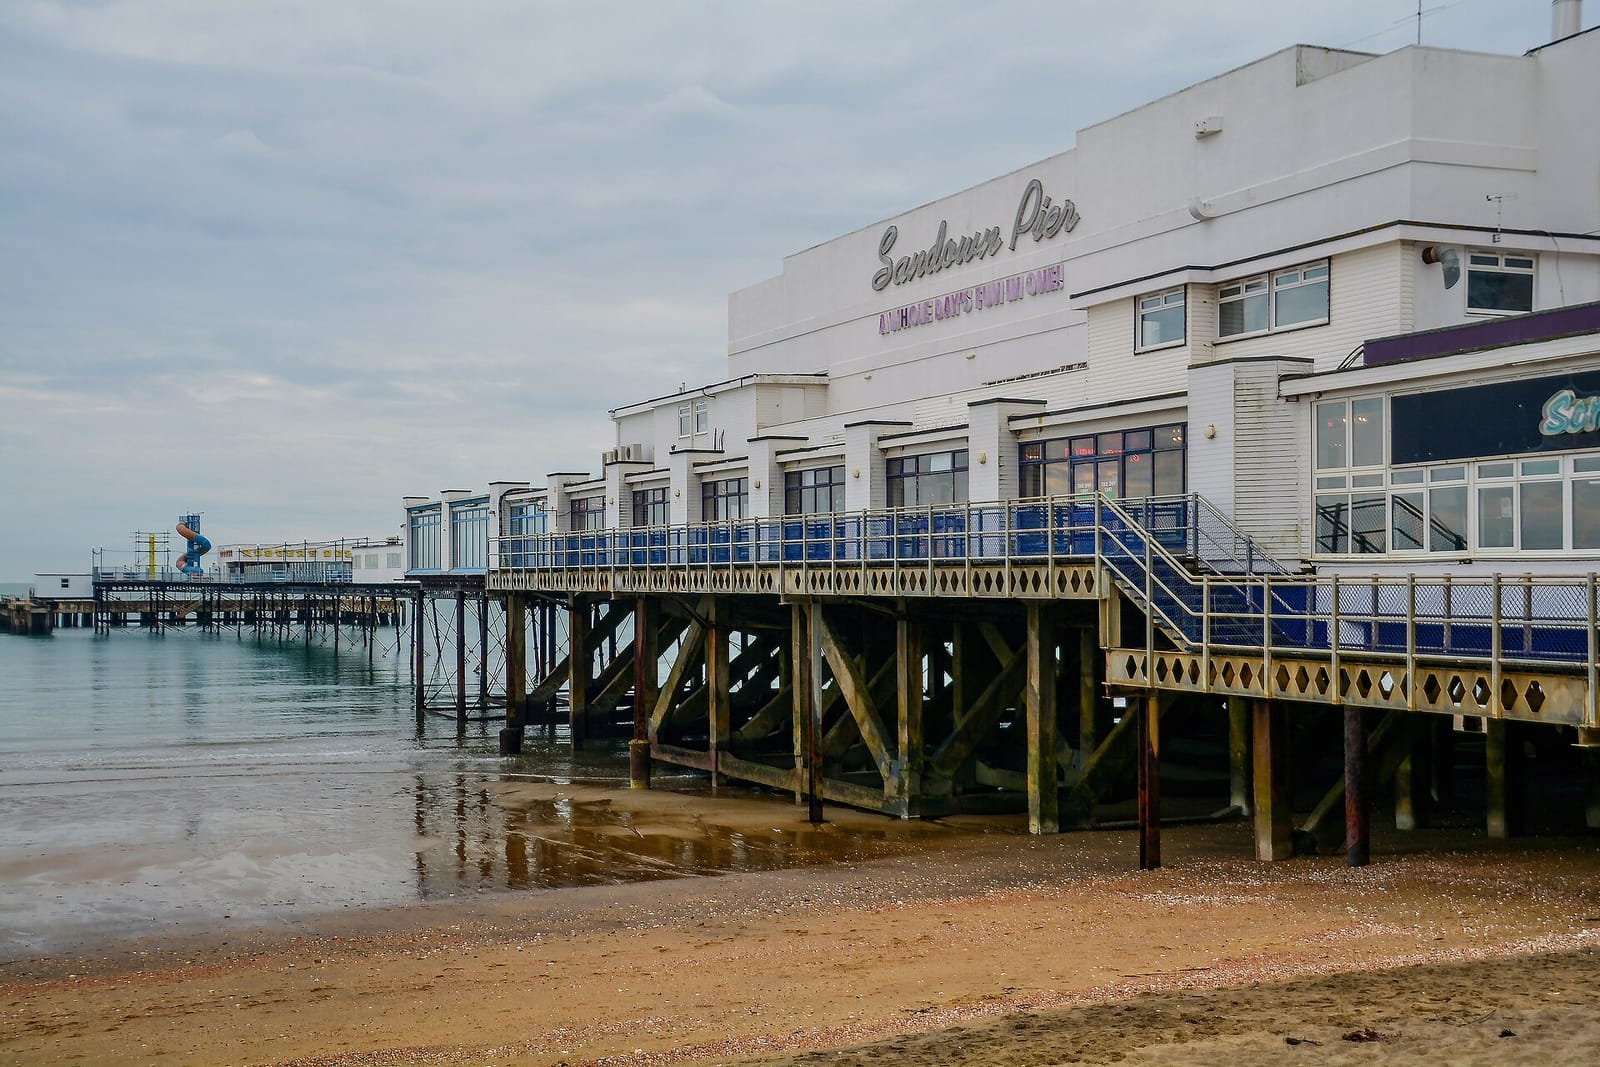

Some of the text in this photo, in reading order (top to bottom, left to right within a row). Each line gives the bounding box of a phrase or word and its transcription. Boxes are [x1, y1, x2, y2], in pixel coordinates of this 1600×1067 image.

[871, 178, 1082, 291] Sandown Pier
[879, 265, 1064, 335] A WHOLE DAY'S FUN IN ONE!
